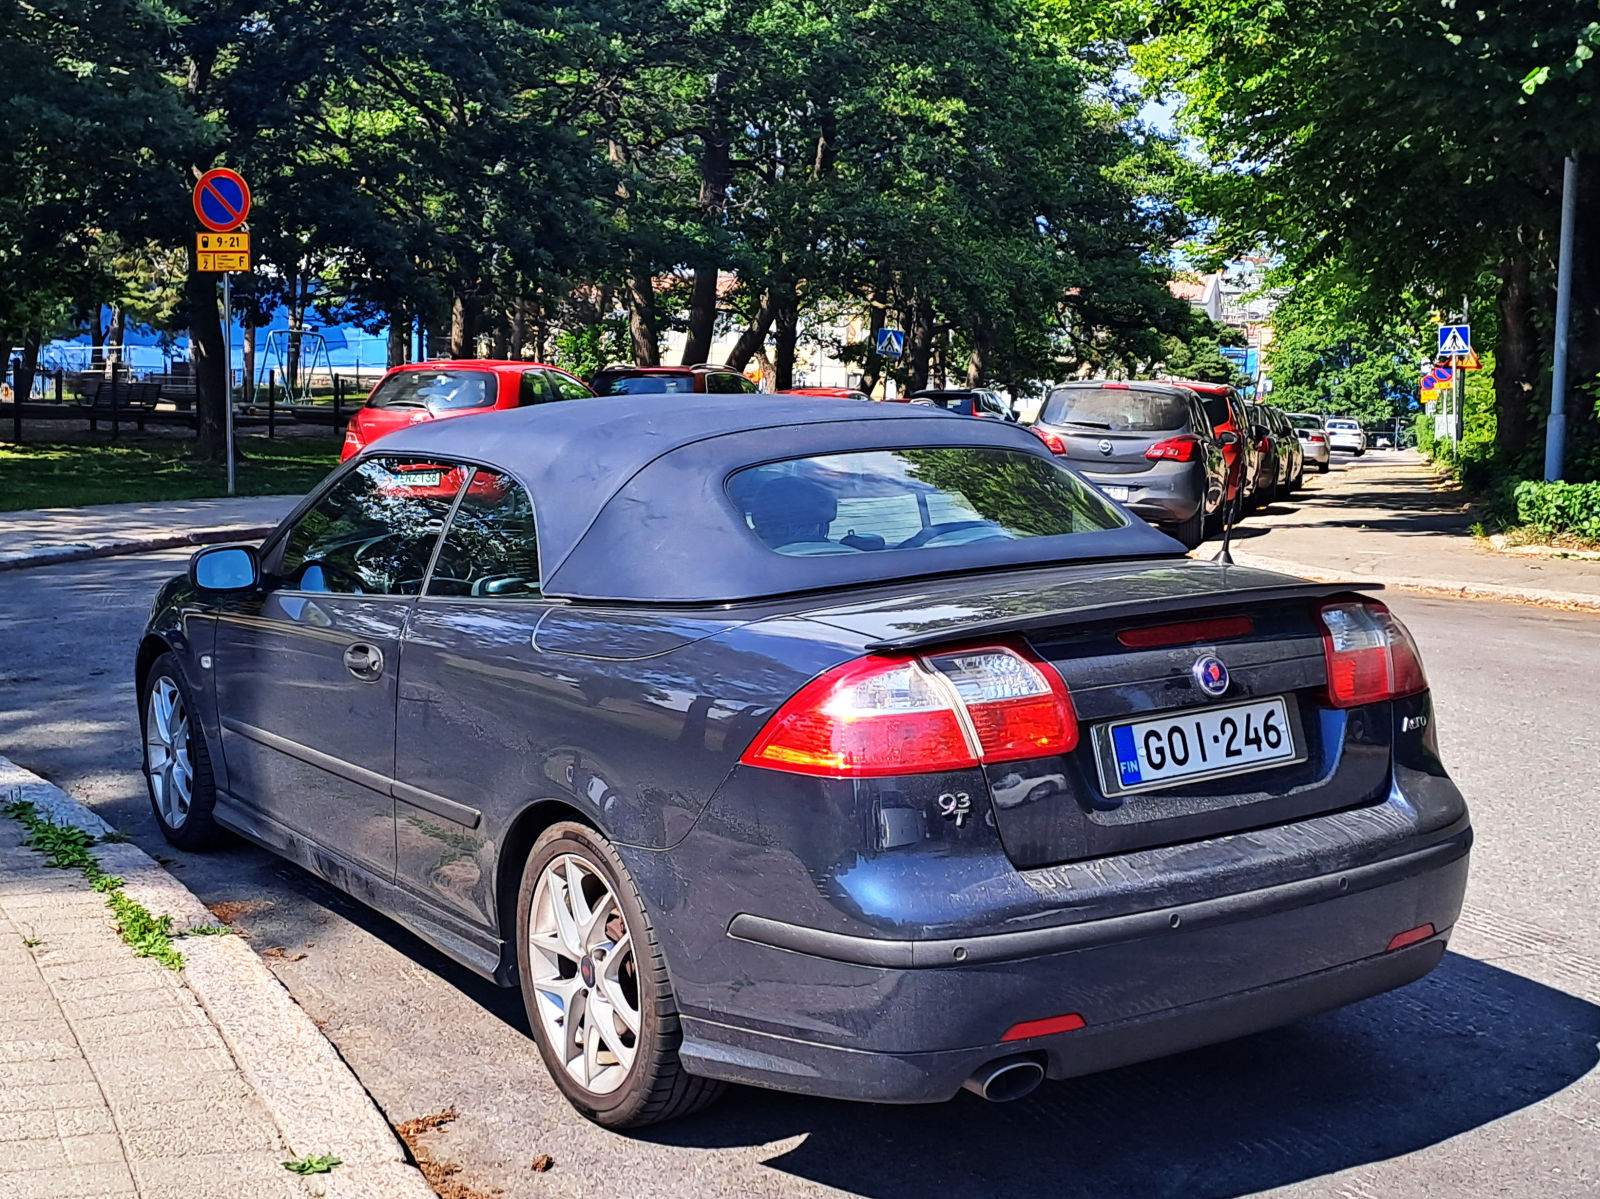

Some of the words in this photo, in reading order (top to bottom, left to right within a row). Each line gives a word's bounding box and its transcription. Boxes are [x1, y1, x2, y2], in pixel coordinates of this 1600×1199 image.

[217, 236, 239, 247] 9-21
[1143, 709, 1282, 770] GOI-246
[1120, 760, 1139, 774] FIN
